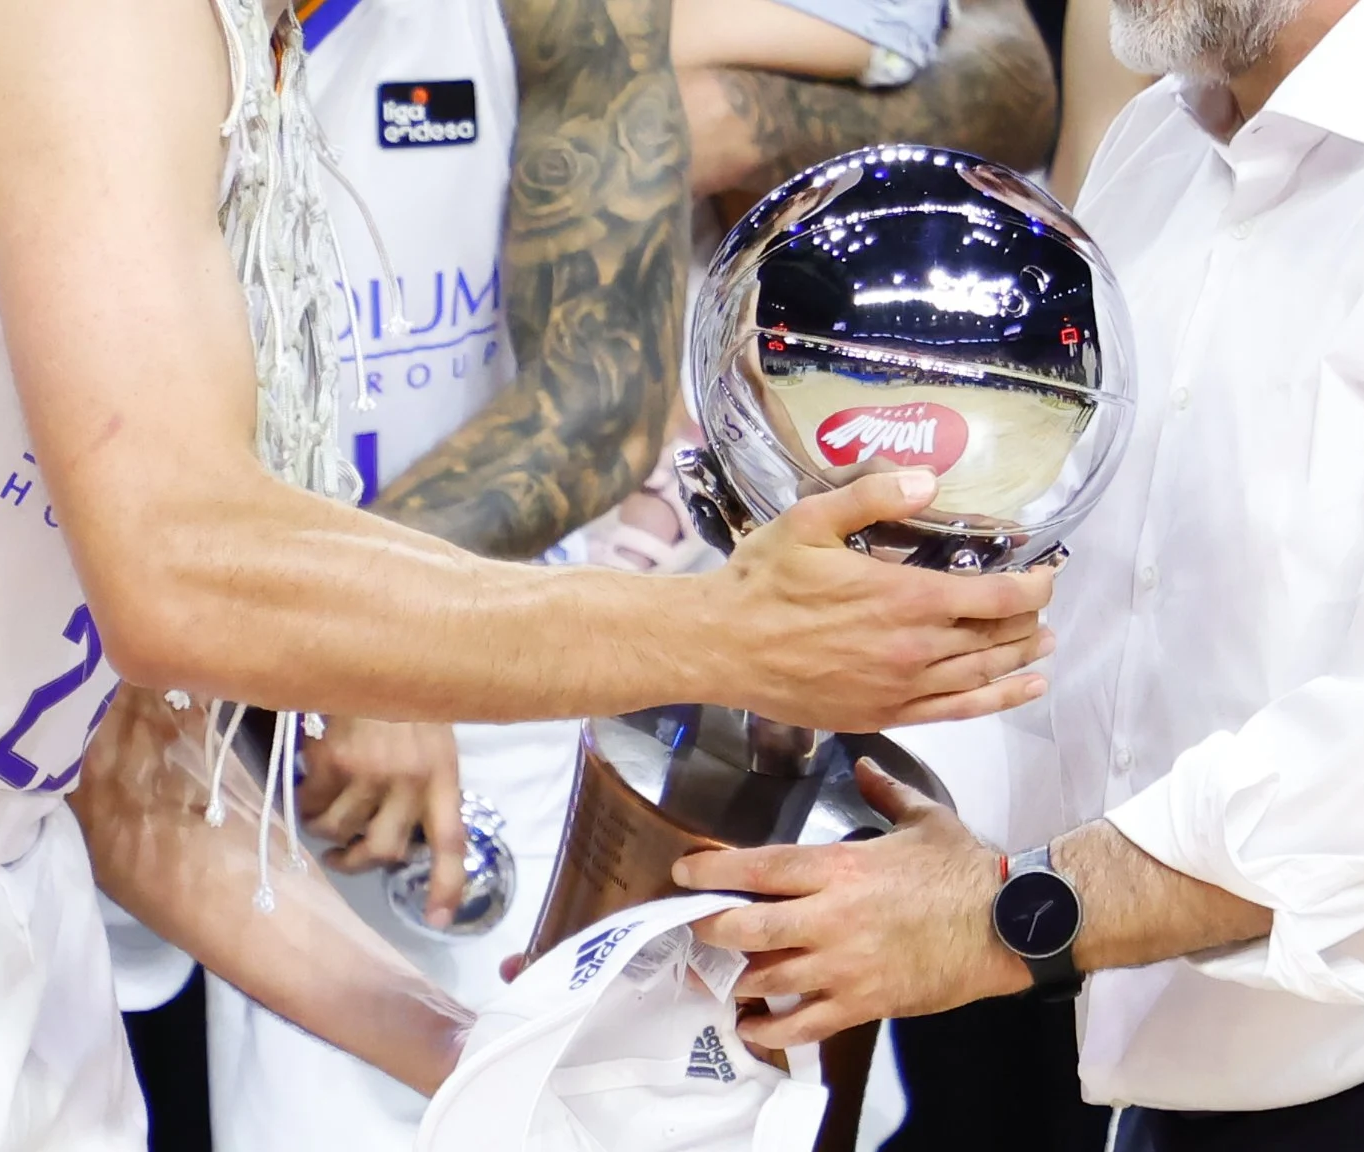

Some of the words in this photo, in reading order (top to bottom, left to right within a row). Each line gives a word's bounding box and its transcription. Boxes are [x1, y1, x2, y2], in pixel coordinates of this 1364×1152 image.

[383, 101, 426, 125] liga
[384, 121, 475, 143] endesa
[568, 920, 645, 991] adidas
